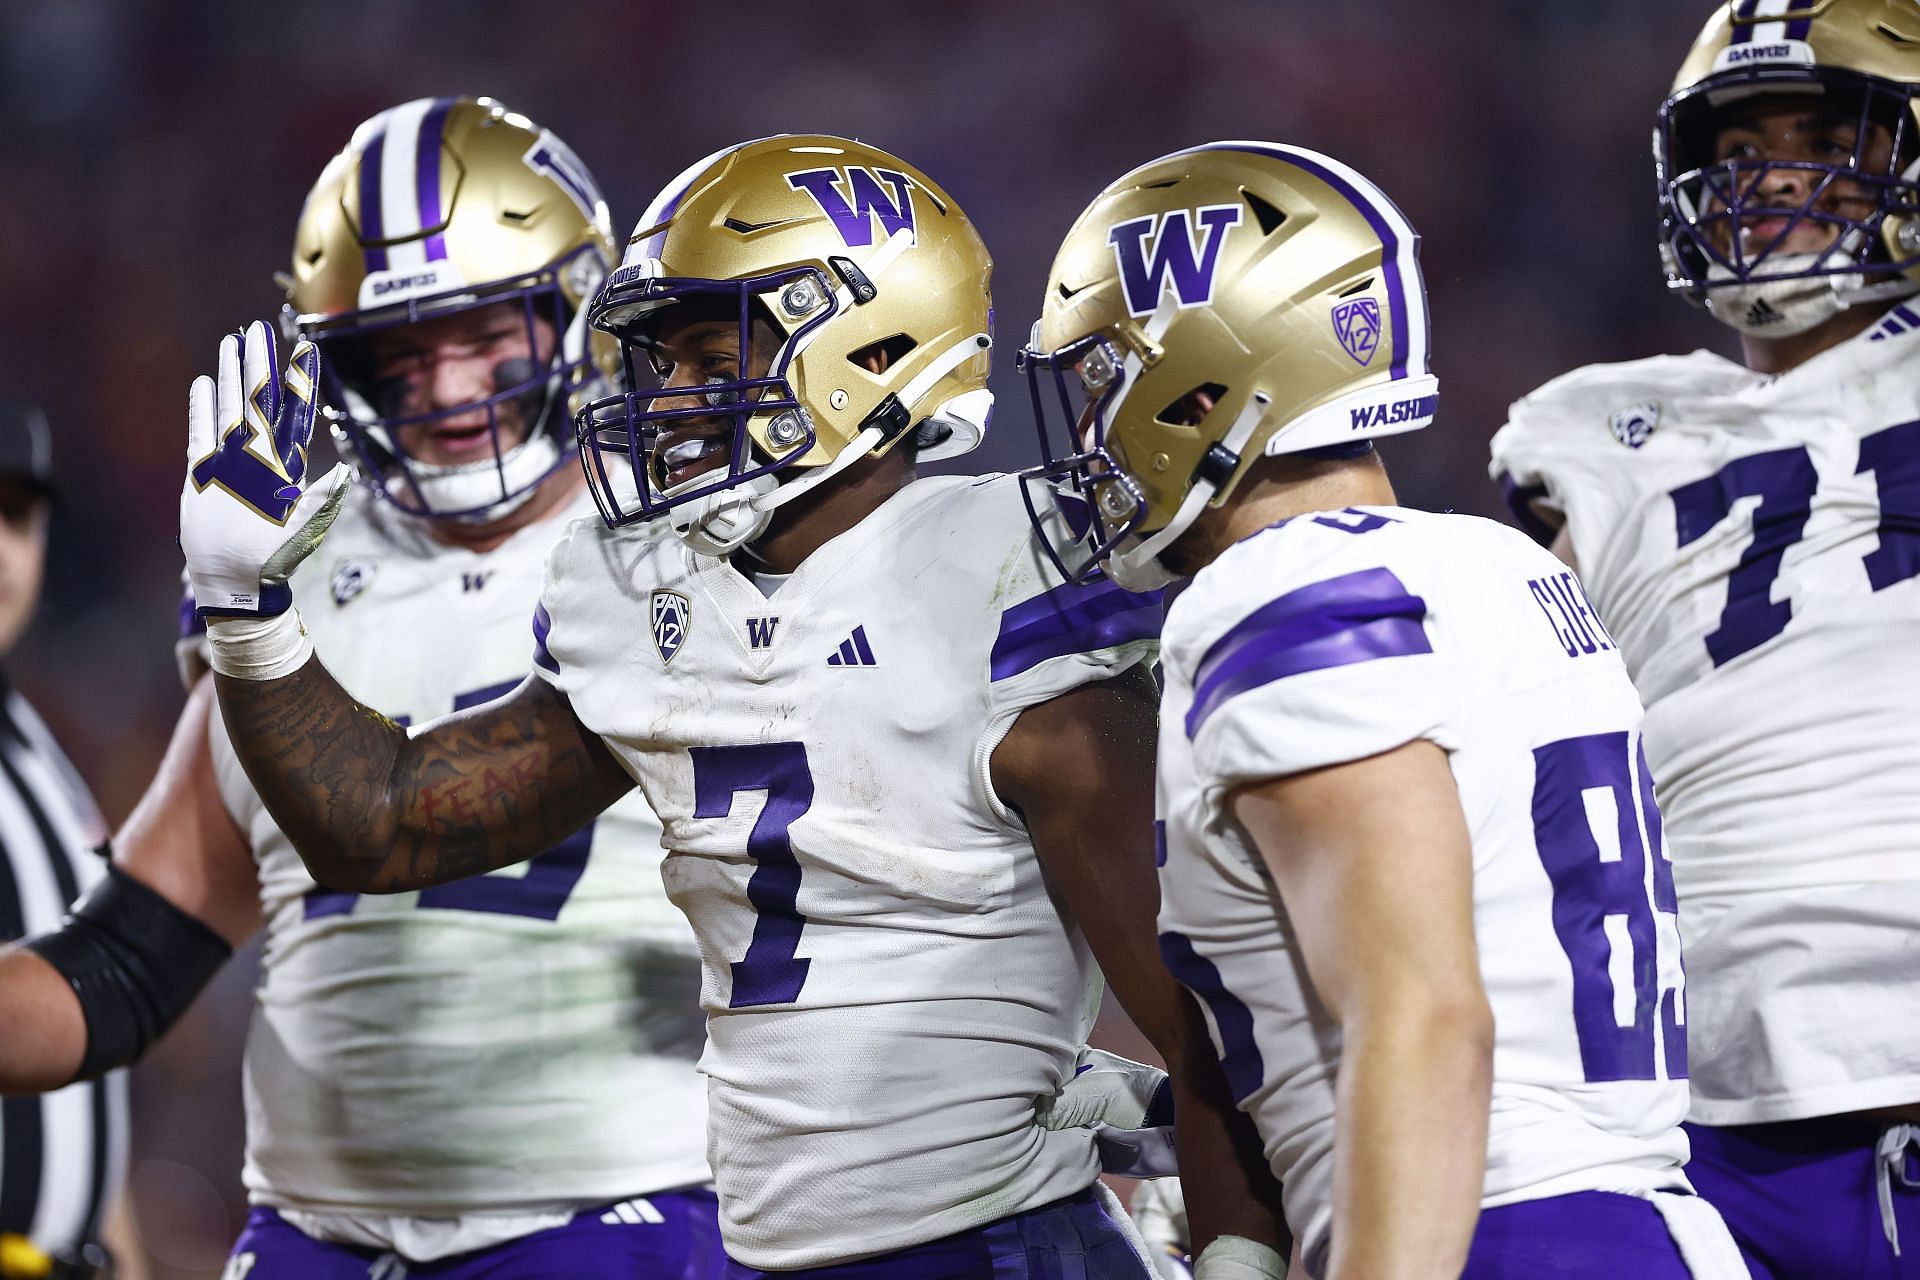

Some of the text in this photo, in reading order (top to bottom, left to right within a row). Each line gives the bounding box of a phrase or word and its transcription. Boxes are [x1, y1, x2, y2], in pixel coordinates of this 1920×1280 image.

[783, 165, 916, 247] W
[1106, 203, 1243, 318] W
[1336, 301, 1378, 342] PAC
[1349, 327, 1374, 353] 12
[652, 594, 688, 637] PAC
[658, 622, 682, 650] 12
[746, 617, 778, 649] W
[691, 741, 813, 1008] 7
